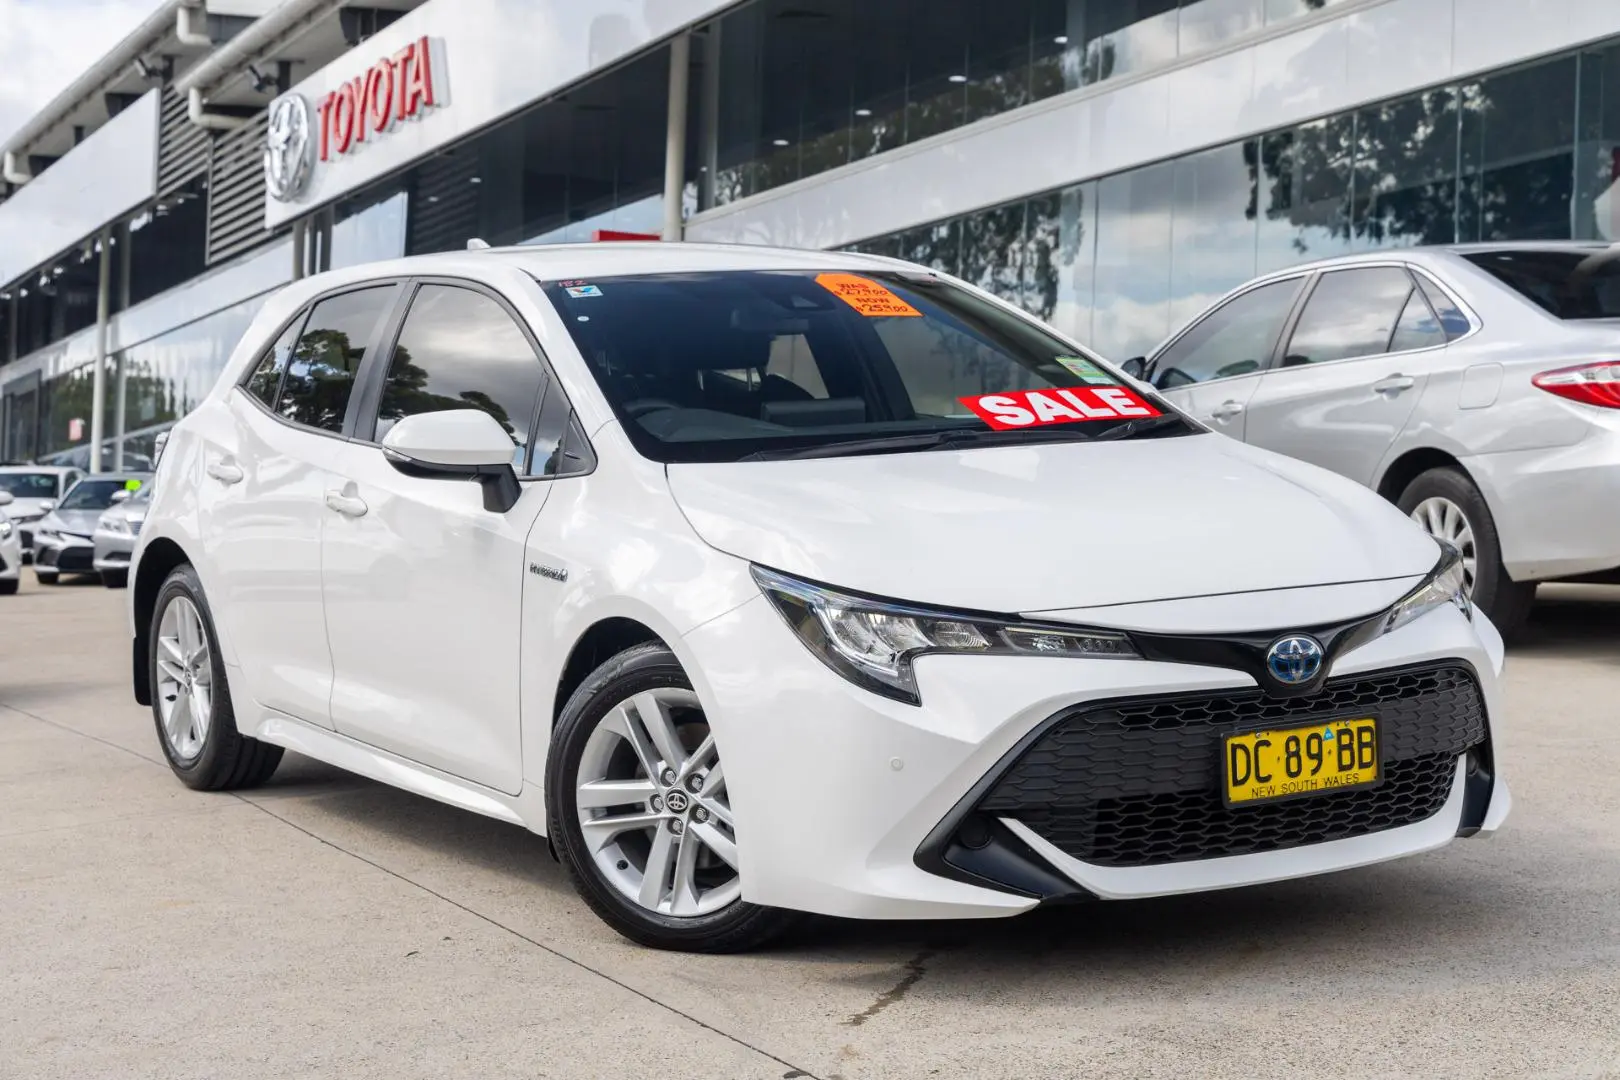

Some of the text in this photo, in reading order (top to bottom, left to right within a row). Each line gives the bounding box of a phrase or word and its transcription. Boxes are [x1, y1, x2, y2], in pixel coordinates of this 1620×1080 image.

[316, 35, 434, 162] TOYOTA
[978, 387, 1152, 426] SALE
[1231, 726, 1375, 787] DC 89 BB
[1251, 773, 1360, 798] NEW SOUTH WALES
